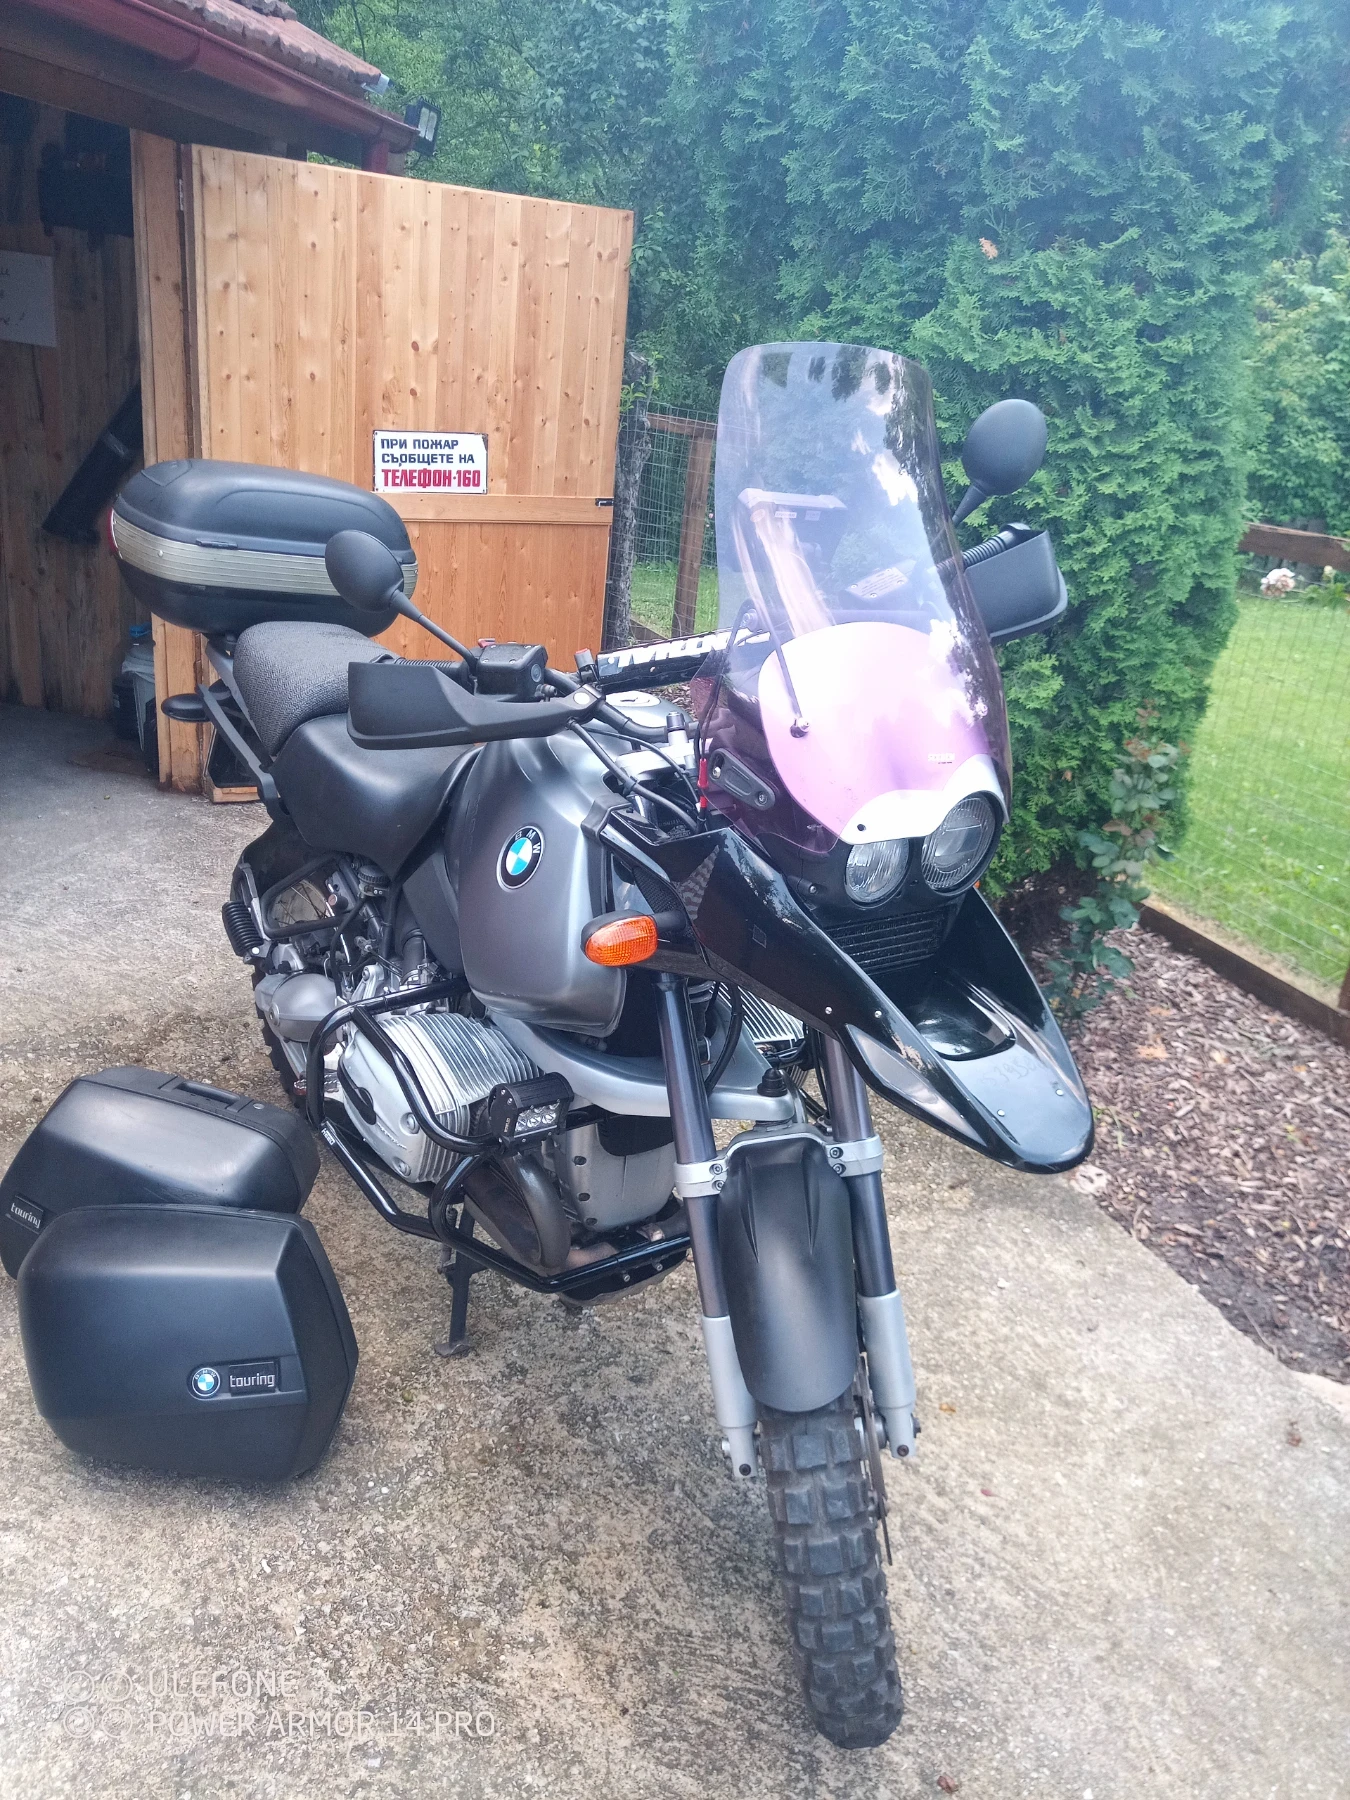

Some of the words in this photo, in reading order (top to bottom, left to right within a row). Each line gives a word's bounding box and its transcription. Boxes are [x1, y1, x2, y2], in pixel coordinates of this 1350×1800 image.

[380, 438, 408, 450] ПРИ
[412, 439, 459, 450] ПОЖАР
[381, 453, 454, 466] СЪОБЩЕТЕ
[458, 453, 475, 464] НА
[10, 1202, 41, 1229] touring
[229, 1372, 276, 1388] touring
